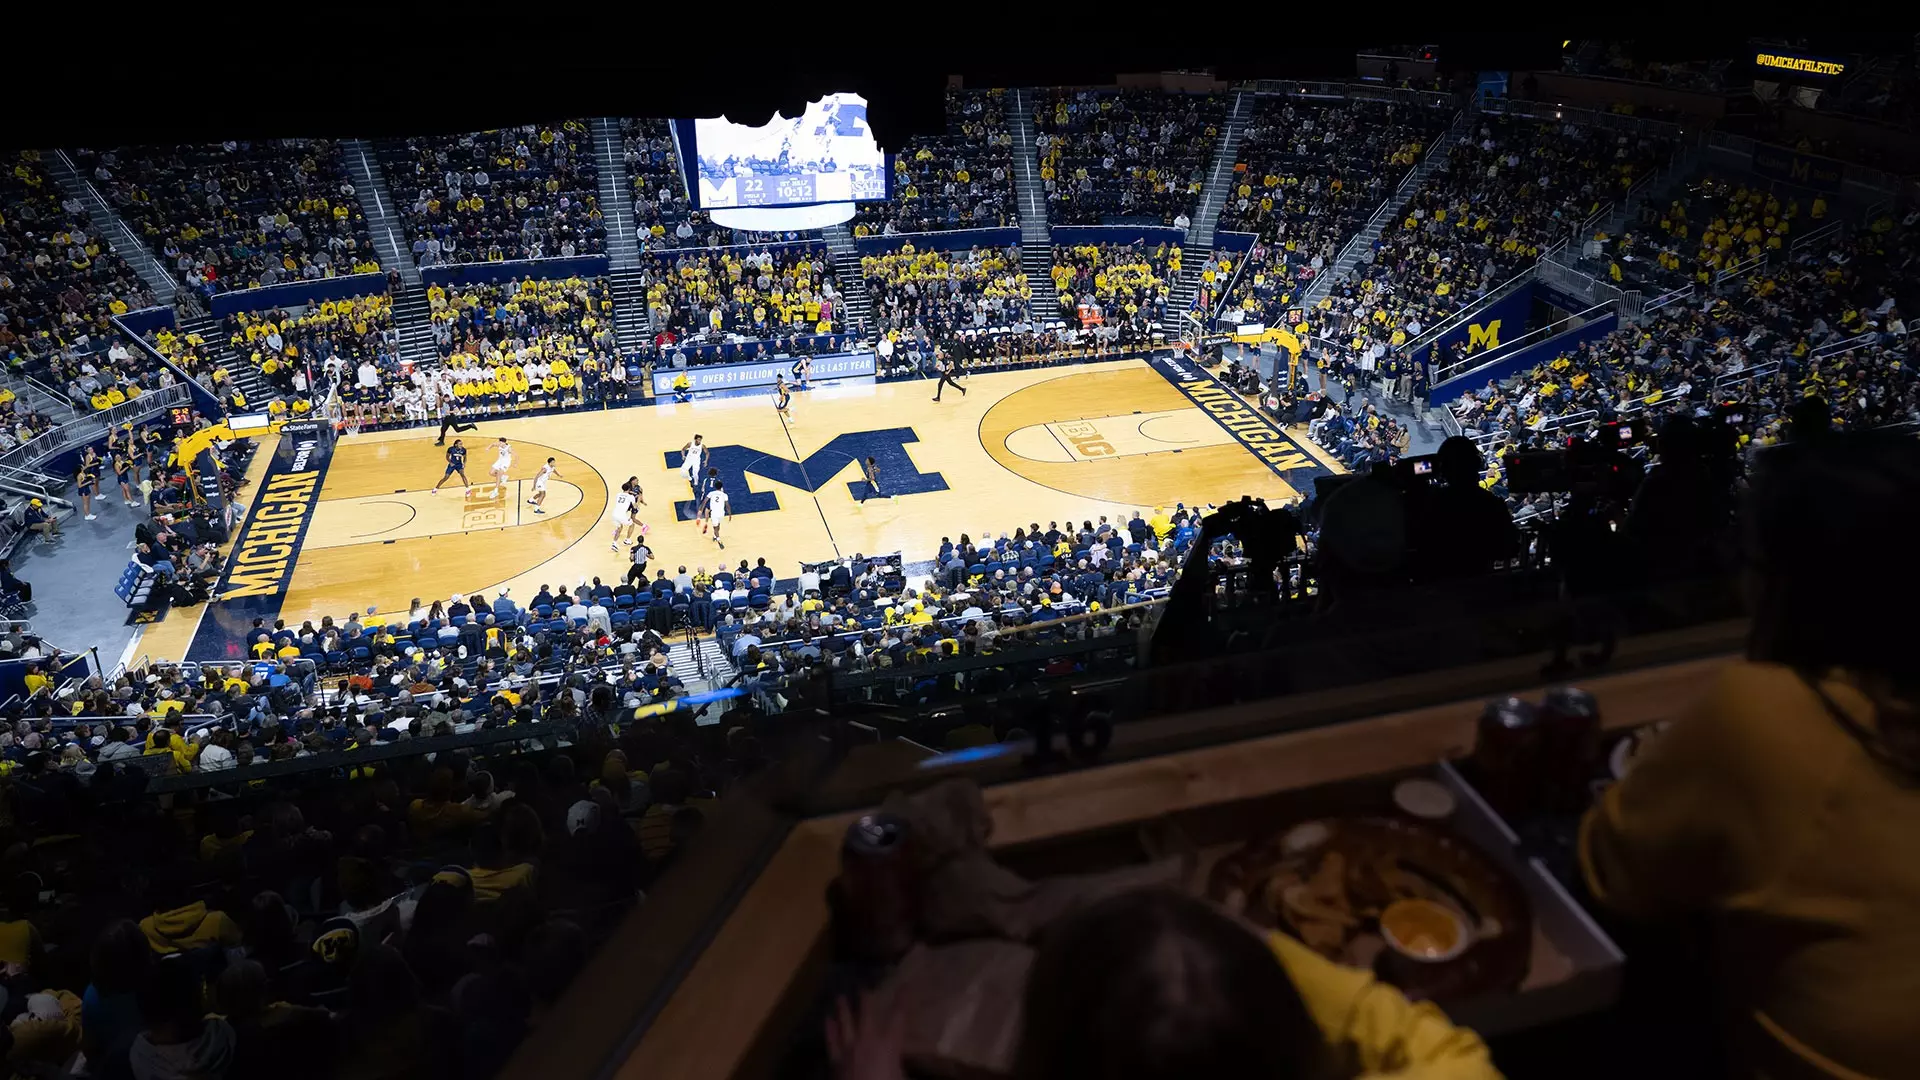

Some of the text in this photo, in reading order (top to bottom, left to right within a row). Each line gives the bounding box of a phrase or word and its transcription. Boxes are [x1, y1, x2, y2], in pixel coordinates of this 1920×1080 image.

[1756, 53, 1845, 75] @UMICHATHLETICS
[744, 179, 763, 192] 22
[776, 185, 813, 197] 10:12
[702, 373, 724, 385] OVER
[727, 371, 738, 382] $1
[740, 369, 773, 381] BILLION
[827, 362, 849, 373] LAST
[850, 359, 871, 371] YEAR
[1178, 379, 1317, 472] MICHIGAN
[221, 470, 320, 601] MICHIGAN
